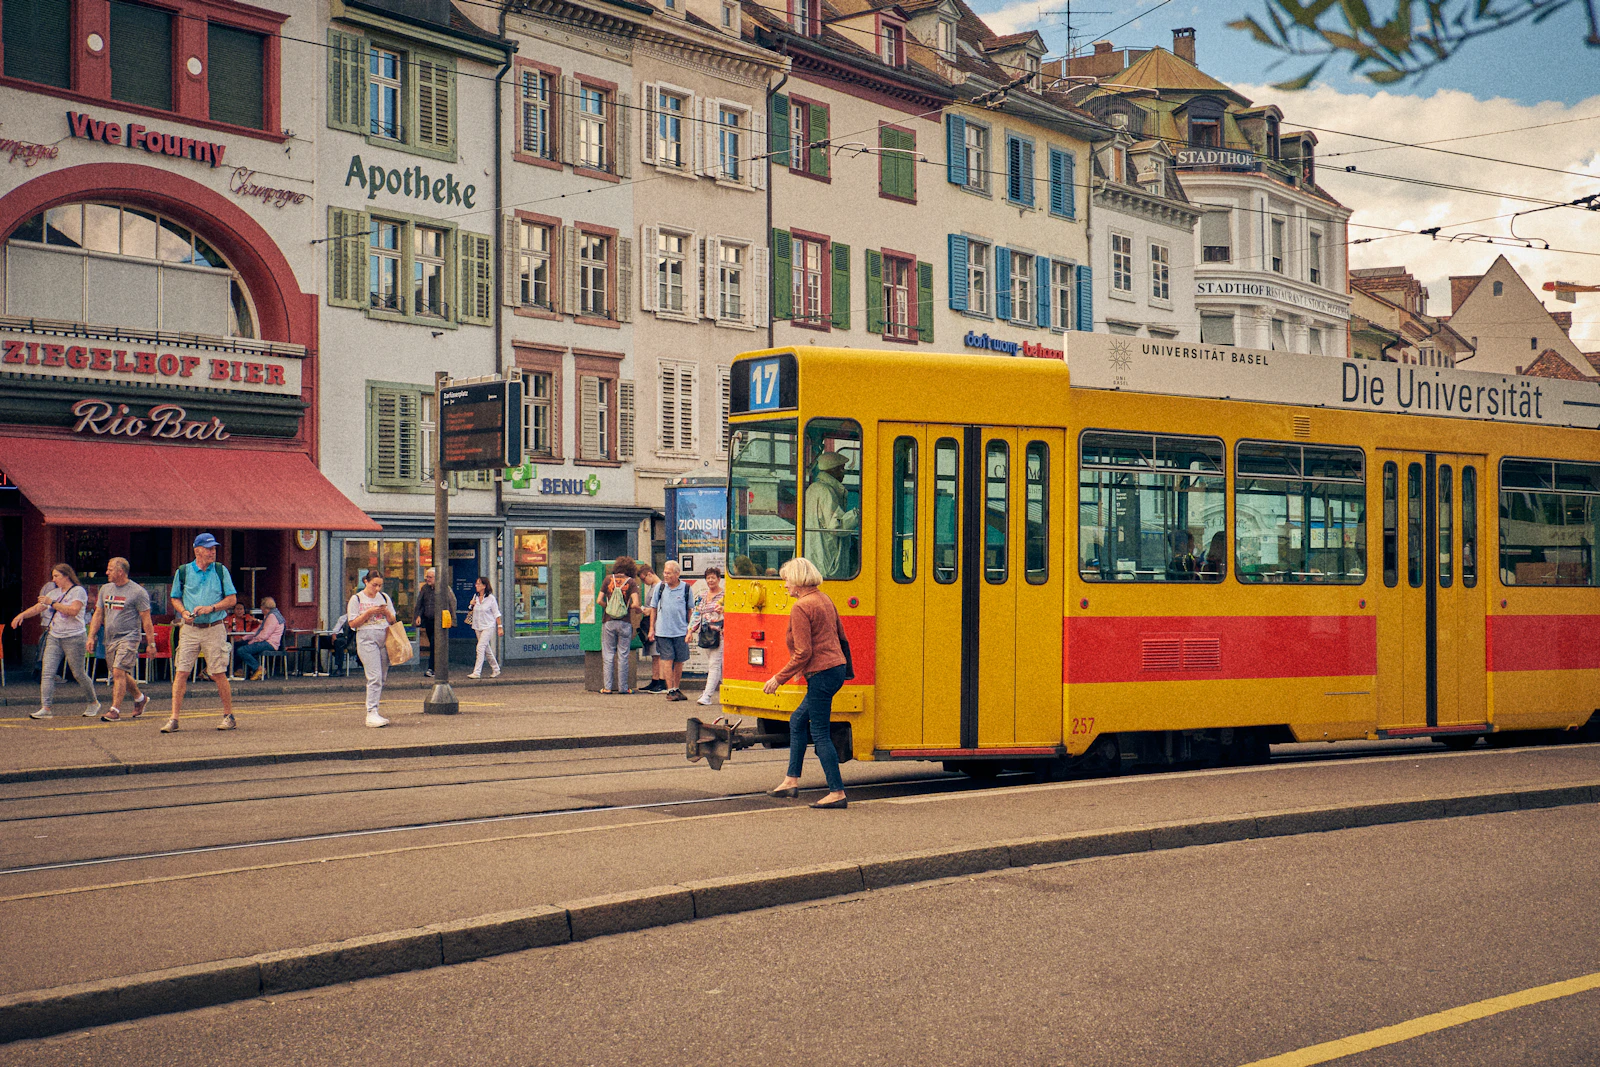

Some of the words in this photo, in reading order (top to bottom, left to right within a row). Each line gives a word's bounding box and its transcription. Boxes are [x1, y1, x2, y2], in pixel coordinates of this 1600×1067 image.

[66, 111, 122, 145] Vve
[127, 123, 226, 168] Fourny
[230, 166, 306, 208] Champagne
[345, 154, 476, 209] Apotheke
[1197, 283, 1264, 296] STADTHOF
[964, 331, 992, 349] don't
[1023, 341, 1037, 357] be
[1142, 344, 1225, 362] UNIVERSITÄT
[1231, 352, 1269, 366] BASEL
[3, 340, 200, 377] ZIEGELHOF
[209, 359, 286, 385] BIER
[752, 363, 779, 405] 17
[1342, 362, 1385, 406] Die
[1397, 368, 1543, 419] Universität
[71, 399, 146, 436] Rio
[148, 403, 231, 441] Bar
[542, 478, 583, 495] BENU
[523, 643, 541, 652] BENU
[550, 642, 580, 652] Apotheke
[1072, 717, 1095, 735] 257
